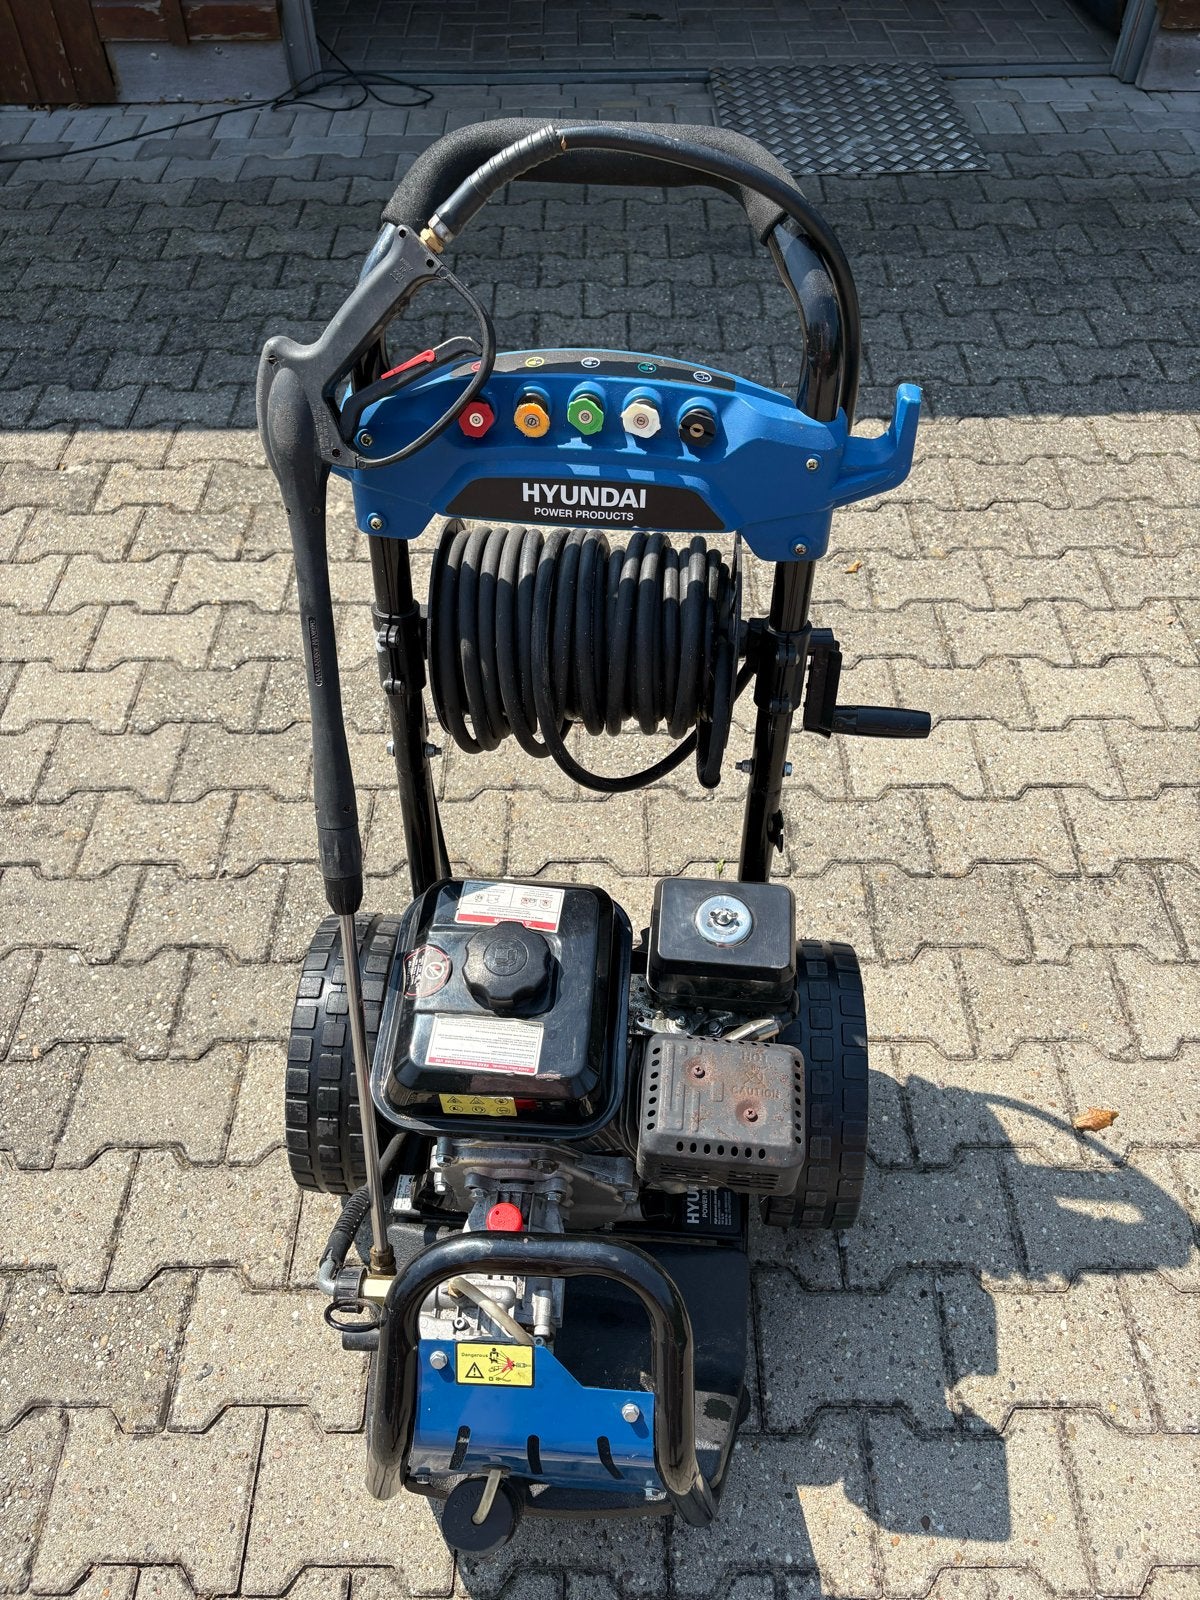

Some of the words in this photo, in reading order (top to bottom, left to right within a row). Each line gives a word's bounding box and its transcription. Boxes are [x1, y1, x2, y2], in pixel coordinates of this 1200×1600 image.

[522, 482, 646, 509] HYUNDAI
[534, 507, 573, 518] POWER
[575, 509, 634, 521] PRODUCTS
[731, 1086, 781, 1099] CAUTION
